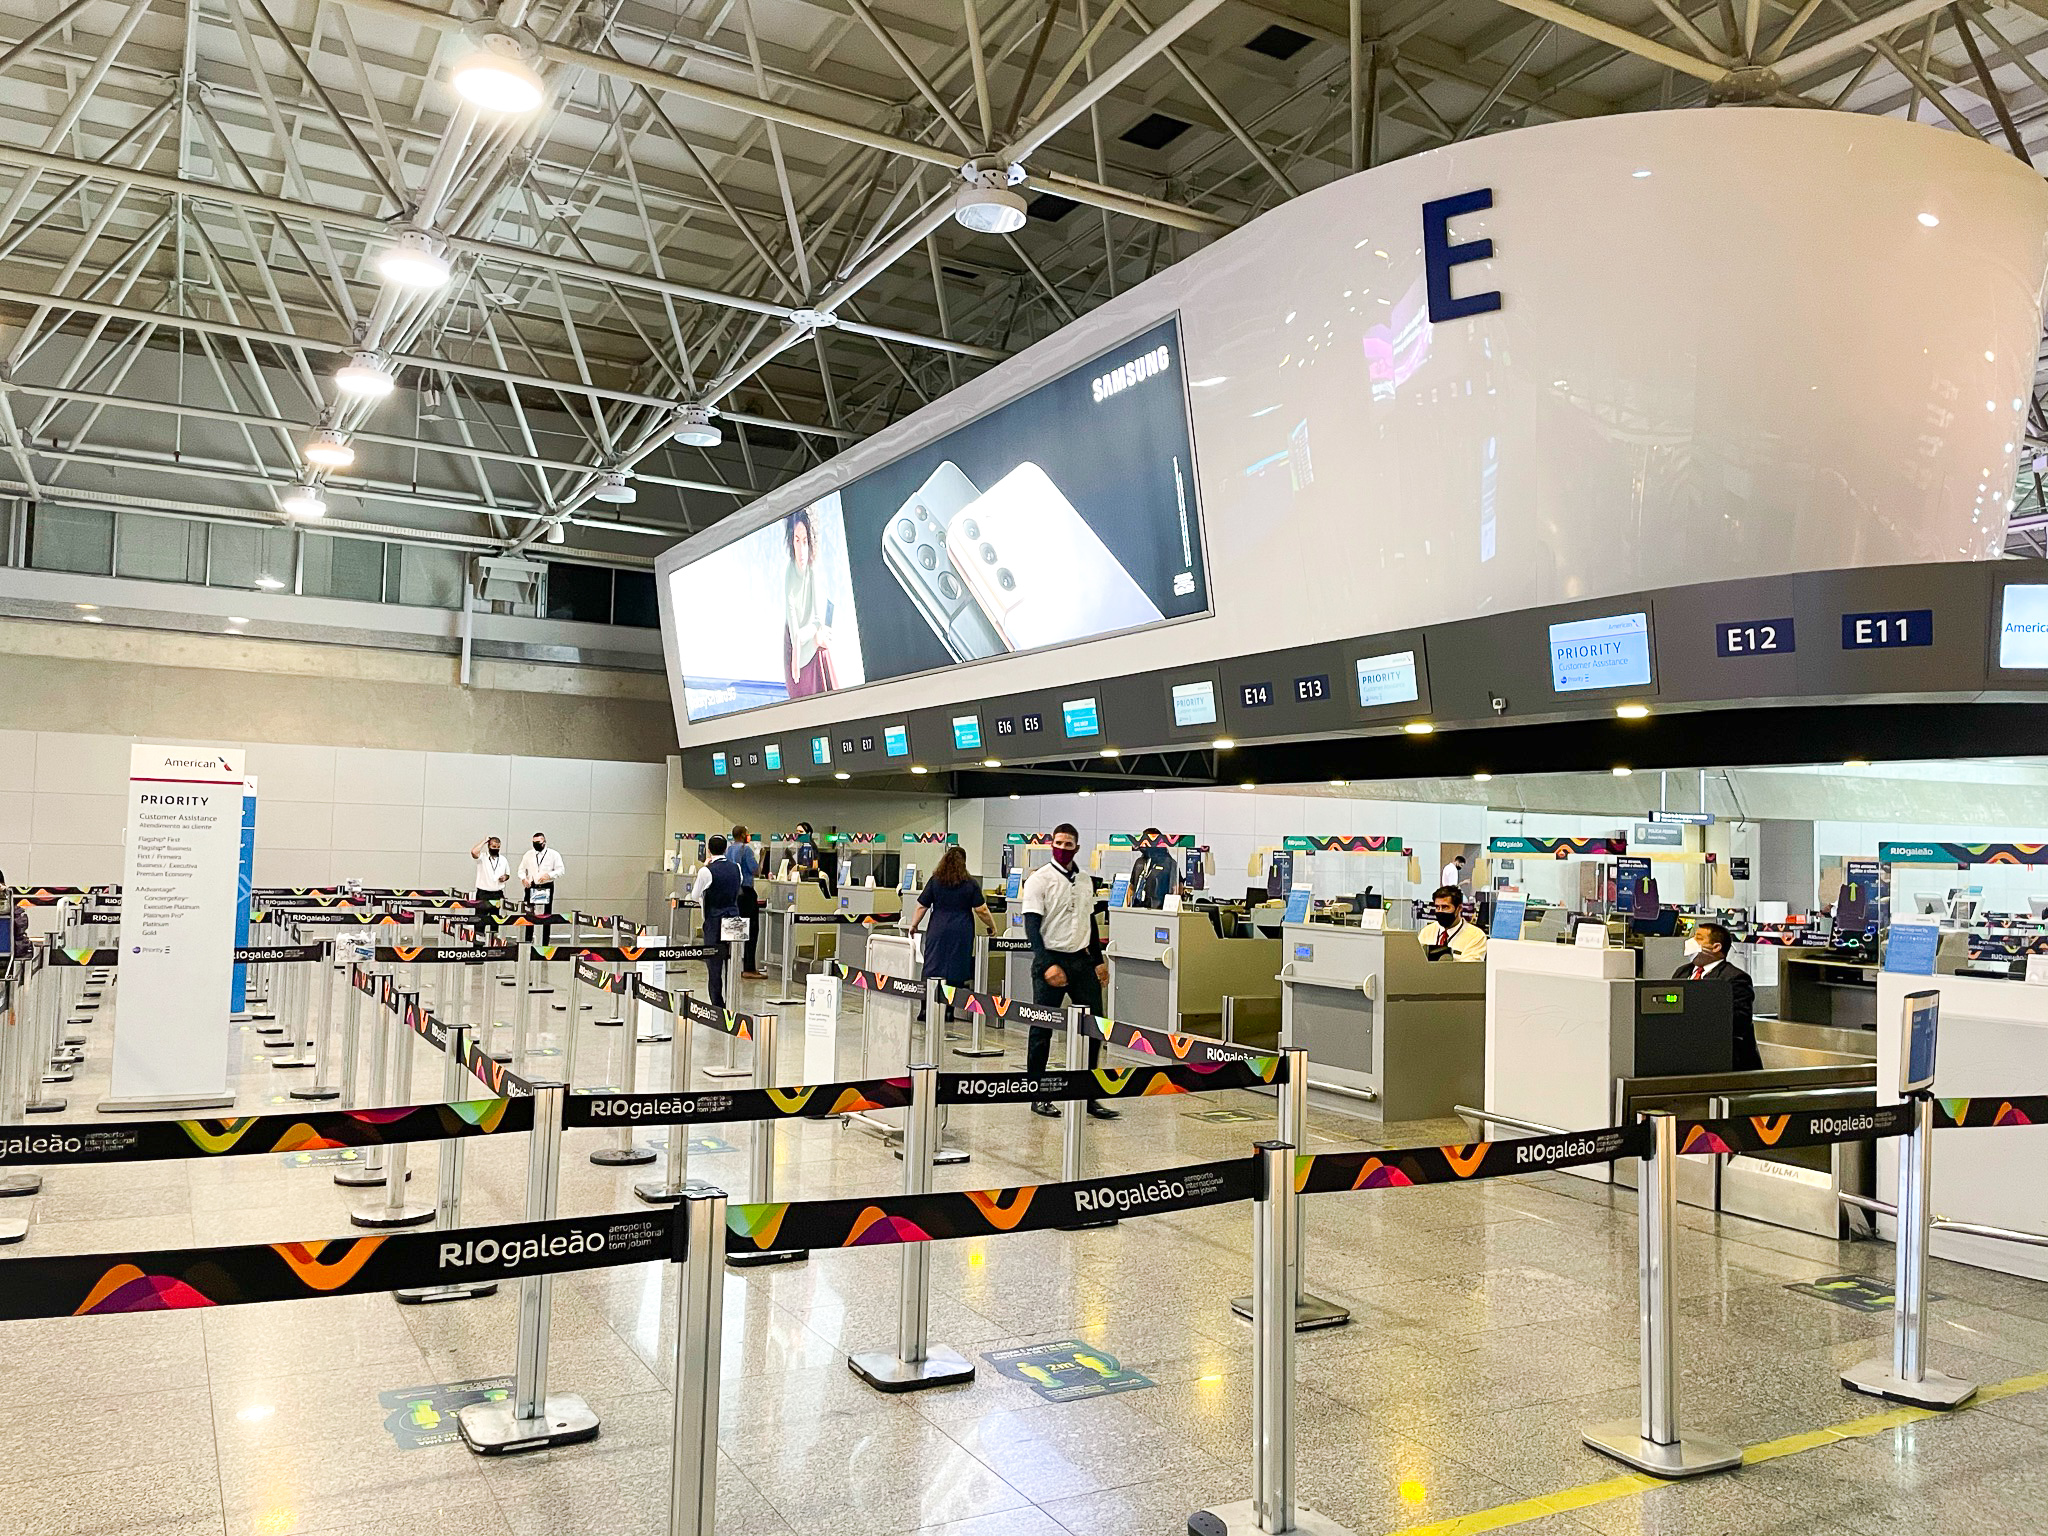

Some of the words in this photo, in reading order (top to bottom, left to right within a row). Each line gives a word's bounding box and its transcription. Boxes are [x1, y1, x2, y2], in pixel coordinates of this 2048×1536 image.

[1422, 187, 1502, 323] E
[1092, 345, 1170, 402] SAMSUNG
[1855, 618, 1909, 644] E11
[2005, 622, 2048, 634] Americ
[1727, 626, 1777, 652] E12
[1557, 641, 1621, 660] PRIORITY
[1558, 661, 1591, 672] Customer
[1592, 658, 1629, 668] Assistance
[1362, 670, 1401, 685] PRIORITY
[1244, 687, 1267, 705] E14
[1299, 680, 1323, 699] E13
[1176, 697, 1204, 708] PRIORITY
[998, 721, 1013, 734] E16
[1024, 717, 1040, 731] E15
[164, 757, 216, 769] American
[140, 795, 209, 806] PRIORITY
[139, 813, 176, 821] Customer
[178, 814, 218, 822] Assistance
[1890, 847, 1934, 857] RIOgaleão
[92, 914, 121, 923] RIOga
[234, 949, 284, 961] IOgaleão
[438, 950, 487, 960] RIOgaleão
[659, 948, 703, 959] RIOgaleão
[1019, 1006, 1052, 1022] RIOgaleão
[957, 1079, 1039, 1097] RIOgaleão
[590, 1097, 695, 1119] RIOgaleão
[1810, 1114, 1874, 1136] RIOgaleão
[1516, 1138, 1596, 1164] RIOgaleão
[1772, 1166, 1799, 1179] ULMA
[1074, 1179, 1185, 1212] RIOgaleão
[608, 1222, 652, 1234] aeroporto
[608, 1228, 664, 1242] internacional
[439, 1230, 606, 1268] RIOgaleão
[608, 1240, 626, 1250] tom
[627, 1238, 652, 1250] jobim
